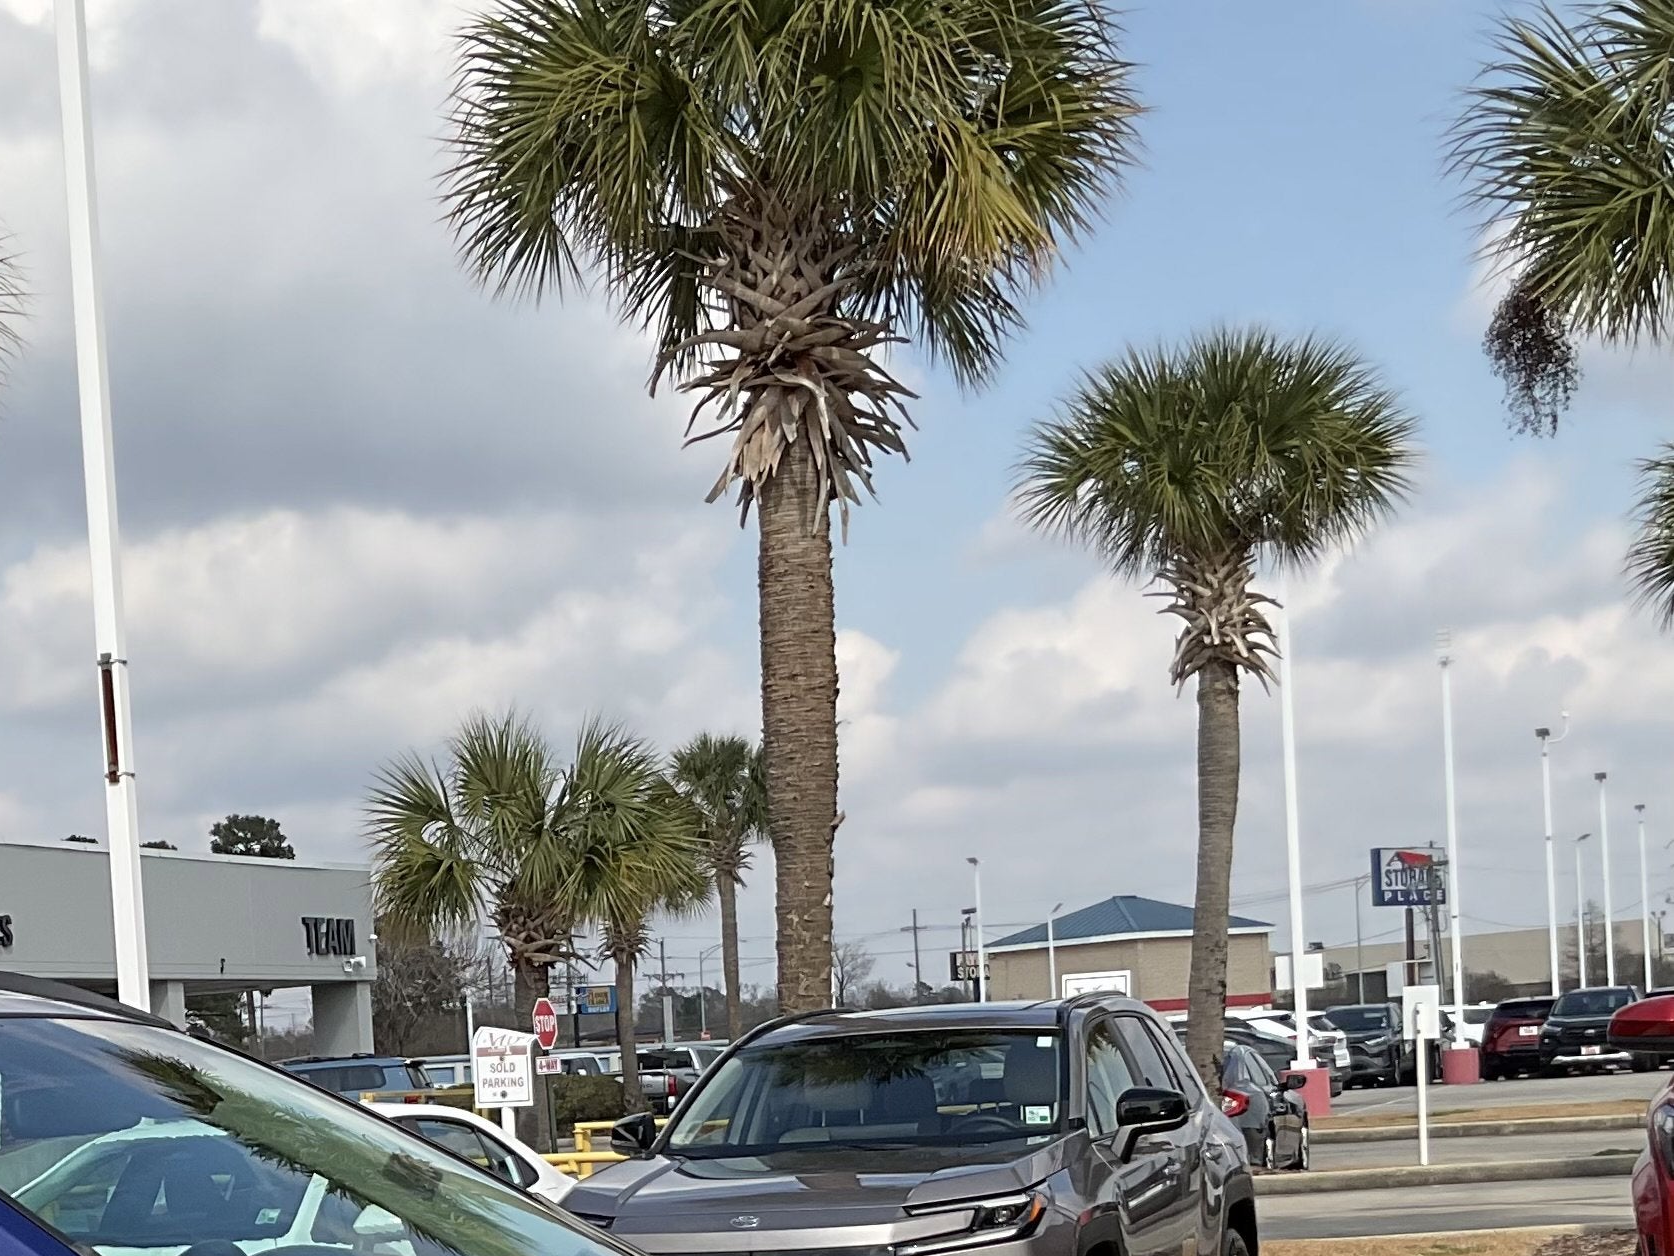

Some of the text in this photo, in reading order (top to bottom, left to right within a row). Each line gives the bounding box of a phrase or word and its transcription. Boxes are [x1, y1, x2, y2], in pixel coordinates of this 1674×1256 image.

[301, 916, 356, 955] TEAM
[534, 1015, 555, 1033] STOP
[489, 1062, 516, 1074] SOLD
[482, 1077, 525, 1088] PARKING
